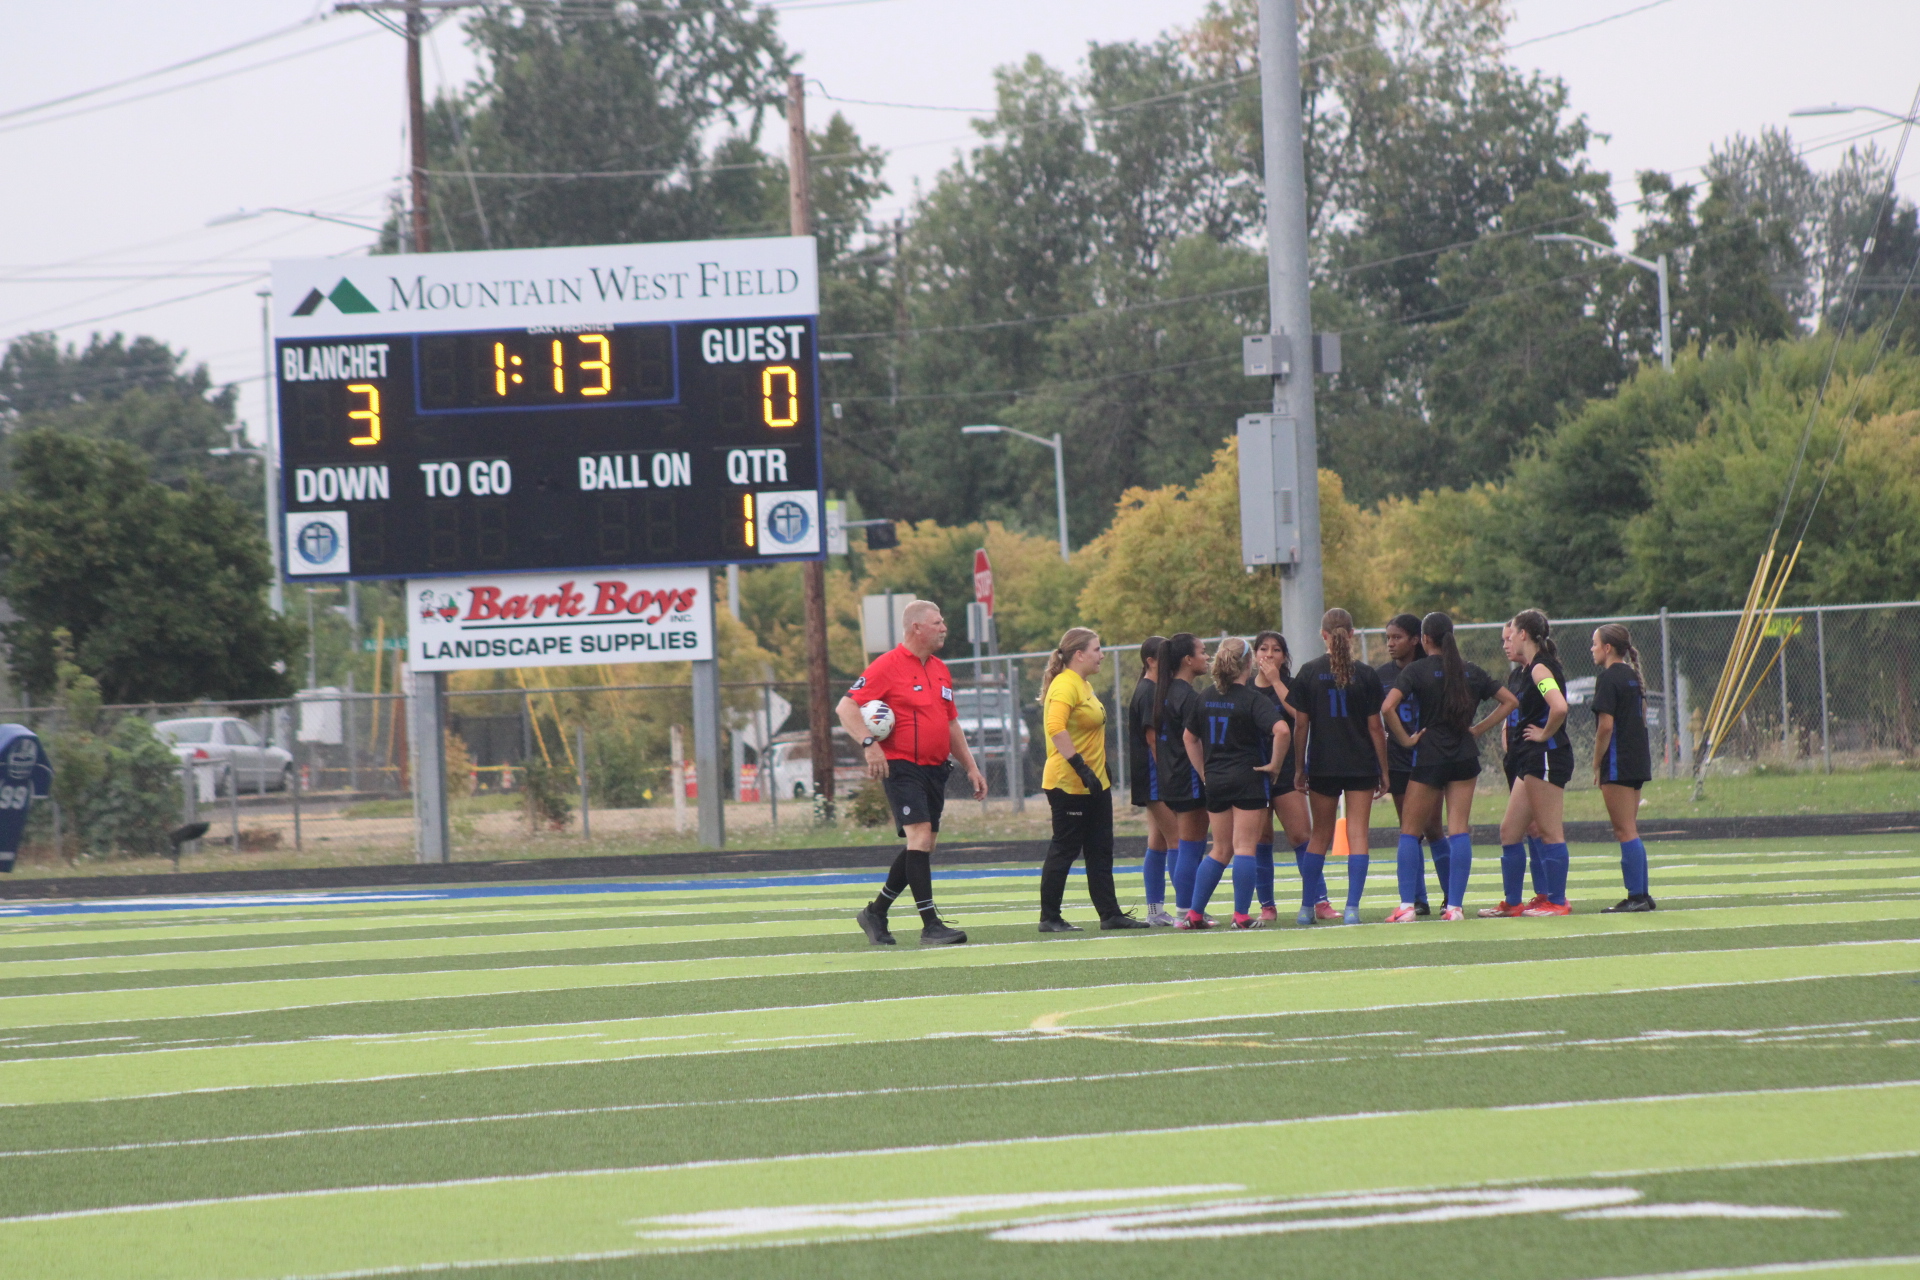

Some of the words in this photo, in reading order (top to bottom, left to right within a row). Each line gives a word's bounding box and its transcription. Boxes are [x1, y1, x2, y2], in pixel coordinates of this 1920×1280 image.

[387, 275, 583, 311] MOUNTAIN
[588, 265, 690, 302] WEST
[697, 261, 800, 298] FIELD
[282, 344, 390, 381] BLANCHET
[701, 325, 805, 364] GUEST
[494, 333, 611, 396] 1:13
[346, 383, 381, 446] 3
[762, 365, 798, 428] 0
[295, 465, 390, 503] DOWN
[419, 462, 461, 497] TO
[467, 459, 512, 496] GO
[578, 454, 648, 490] BALL
[651, 452, 692, 487] ON
[726, 448, 788, 484] QTR
[743, 493, 755, 547] 1
[461, 581, 586, 620] Bark
[587, 581, 698, 625] Boys
[422, 636, 573, 660] LANDSCAPE
[580, 631, 698, 653] SUPPLIES
[1327, 688, 1348, 718] 11
[1208, 715, 1229, 744] 17
